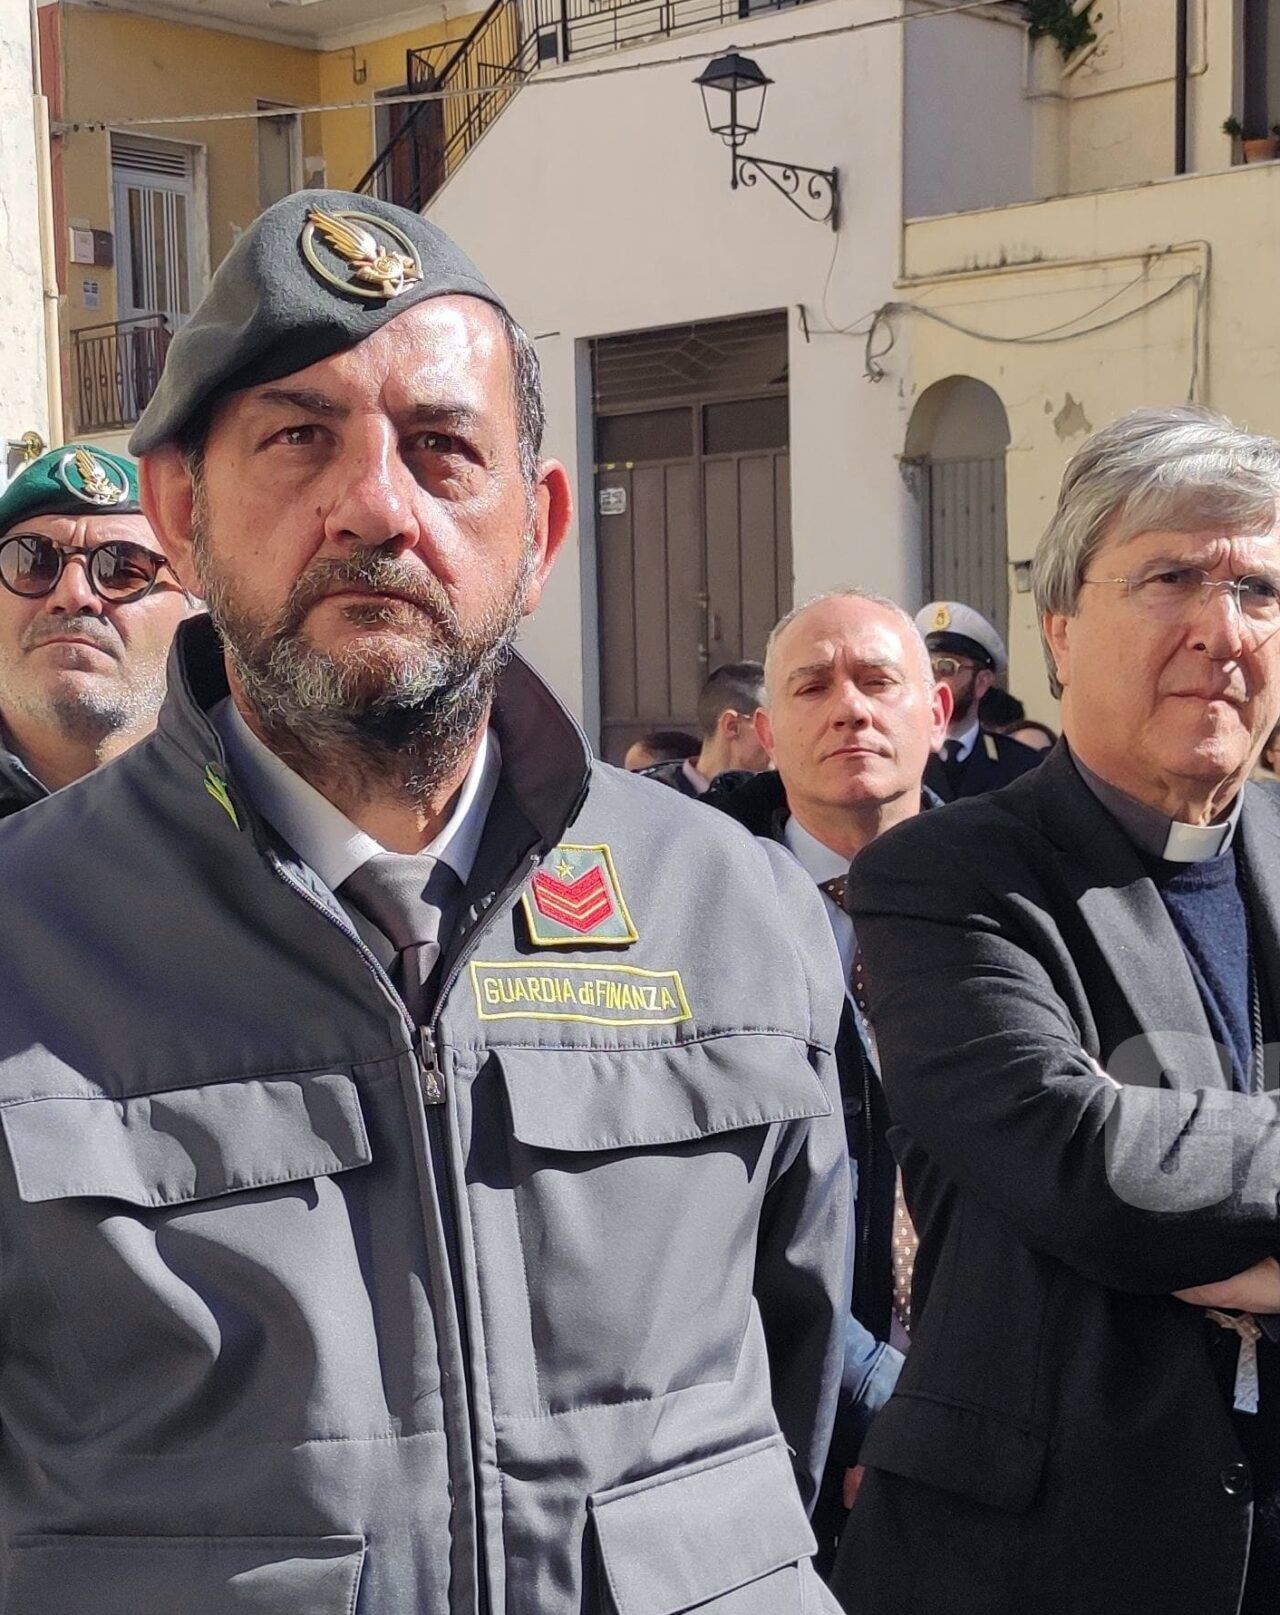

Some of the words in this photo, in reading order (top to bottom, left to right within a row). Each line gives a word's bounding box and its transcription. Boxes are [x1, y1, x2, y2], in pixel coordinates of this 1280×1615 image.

[483, 976, 576, 1004] GUARDIA
[578, 980, 595, 1006] di
[596, 979, 677, 1011] FINANZA
